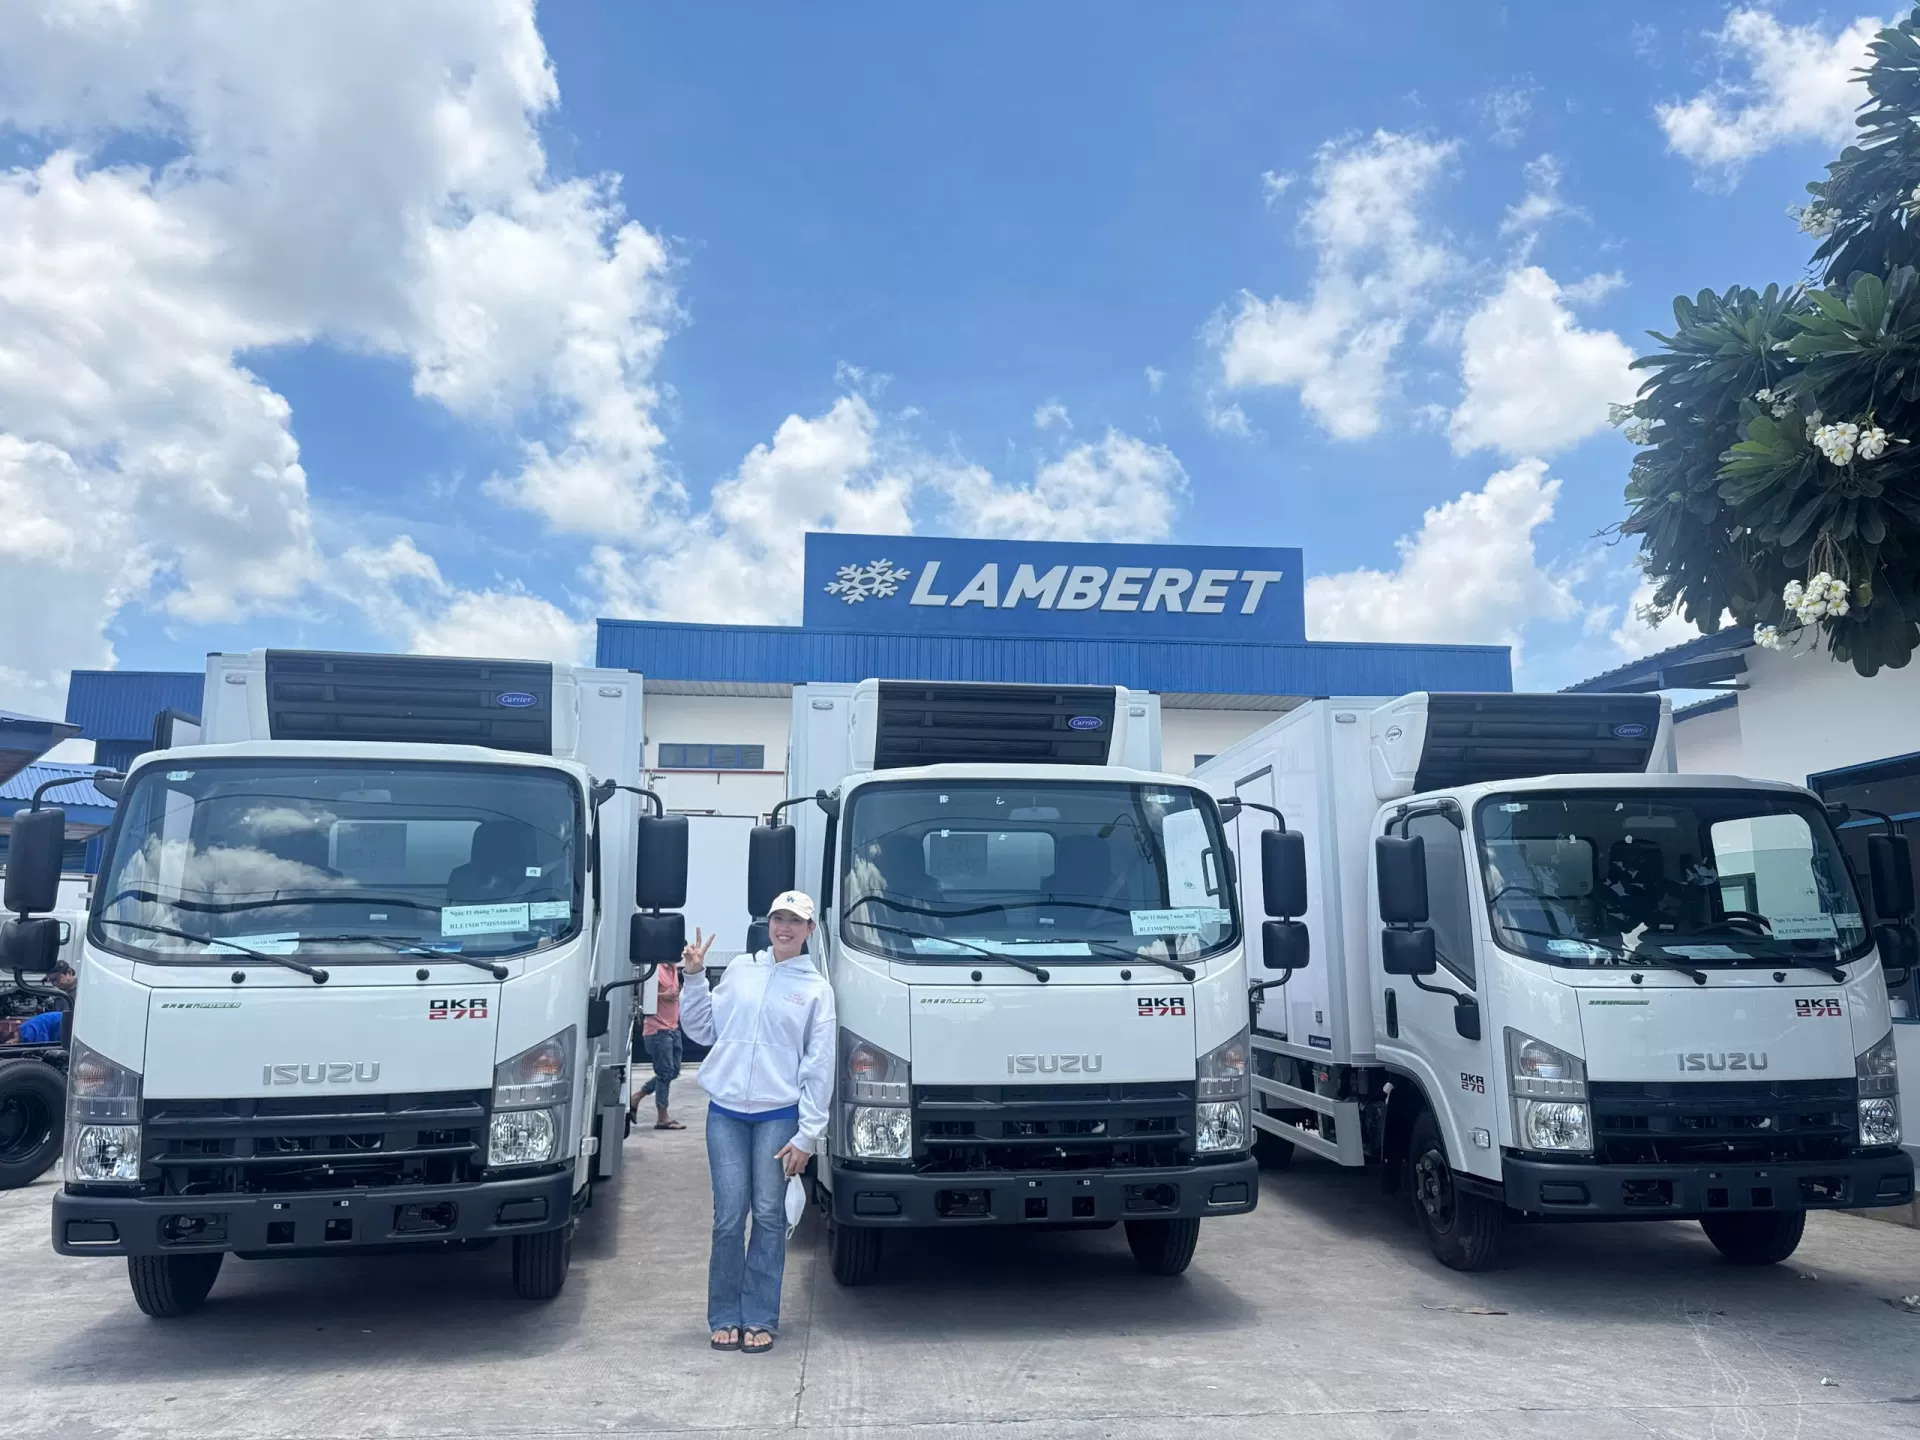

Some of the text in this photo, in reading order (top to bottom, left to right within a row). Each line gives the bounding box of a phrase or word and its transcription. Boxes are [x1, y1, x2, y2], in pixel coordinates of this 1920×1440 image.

[909, 560, 1283, 615] LAMBERET
[501, 695, 533, 704] Carrier
[1072, 719, 1098, 727] Carrier
[1618, 726, 1643, 734] Carrier
[430, 998, 488, 1009] QKR
[1137, 997, 1185, 1007] QKR
[1795, 998, 1840, 1008] QKR
[429, 1008, 488, 1020] 270
[1137, 1006, 1186, 1017] 270
[1796, 1007, 1842, 1017] 270
[1006, 1053, 1102, 1074] ISUZU
[1676, 1052, 1768, 1071] ISUZU
[262, 1060, 380, 1086] ISUZU
[1460, 1072, 1484, 1086] QKR
[1461, 1080, 1485, 1095] 270
